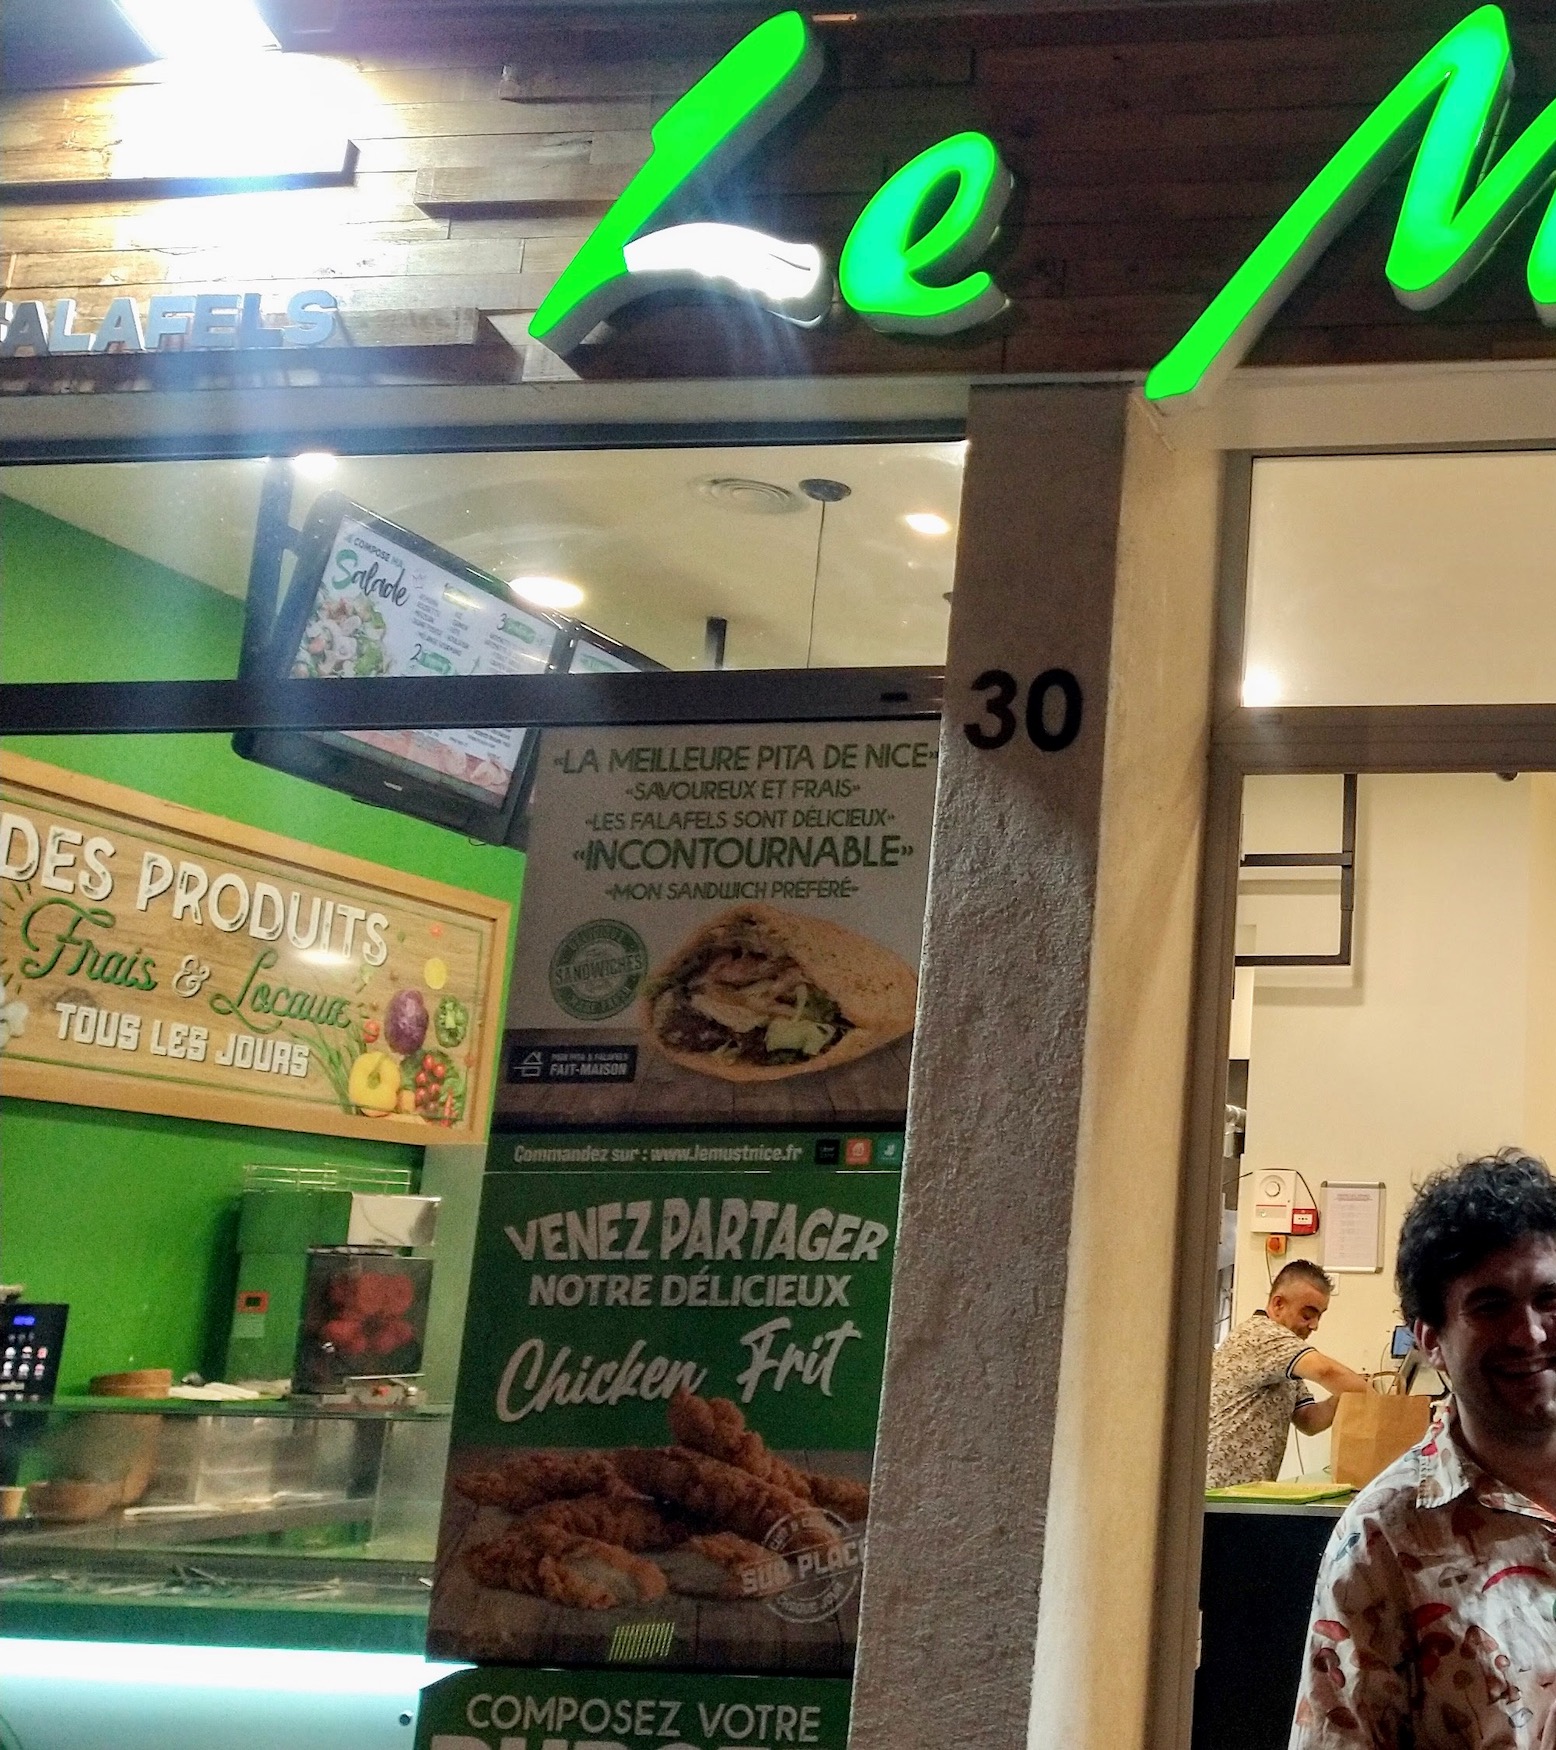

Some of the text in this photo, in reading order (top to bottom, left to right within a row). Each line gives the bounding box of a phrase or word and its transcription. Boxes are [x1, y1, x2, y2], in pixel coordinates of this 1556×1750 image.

[528, 10, 1000, 340] Le
[0, 288, 340, 358] ALAFELS
[331, 549, 410, 607] Salade
[963, 668, 1082, 752] 30
[609, 746, 750, 773] MEILLEURE
[756, 744, 815, 771] PITA
[823, 744, 858, 770] DE
[762, 780, 784, 800] ET
[631, 811, 728, 830] FALAFELS
[733, 809, 787, 829] SONT
[573, 836, 914, 871] «INCONTOURNABLE»
[0, 811, 390, 967] DES PRODUITS
[667, 880, 770, 900] SANDWICH
[20, 896, 351, 1034] Frais & Locaux
[55, 1001, 310, 1078] TOUS LES JOURS
[549, 1063, 628, 1076] FAIT-MAISON
[514, 1144, 609, 1162] Commandez
[613, 1147, 638, 1162] sur
[650, 1144, 802, 1162] www.lemustnice.fr
[504, 1198, 889, 1261] VENEZ PARTAGER
[528, 1265, 853, 1307] NOTRE DÉLICIEUX
[496, 1316, 862, 1422] Chicken Frit
[465, 1693, 821, 1742] COMPOSEZ VOTRE
